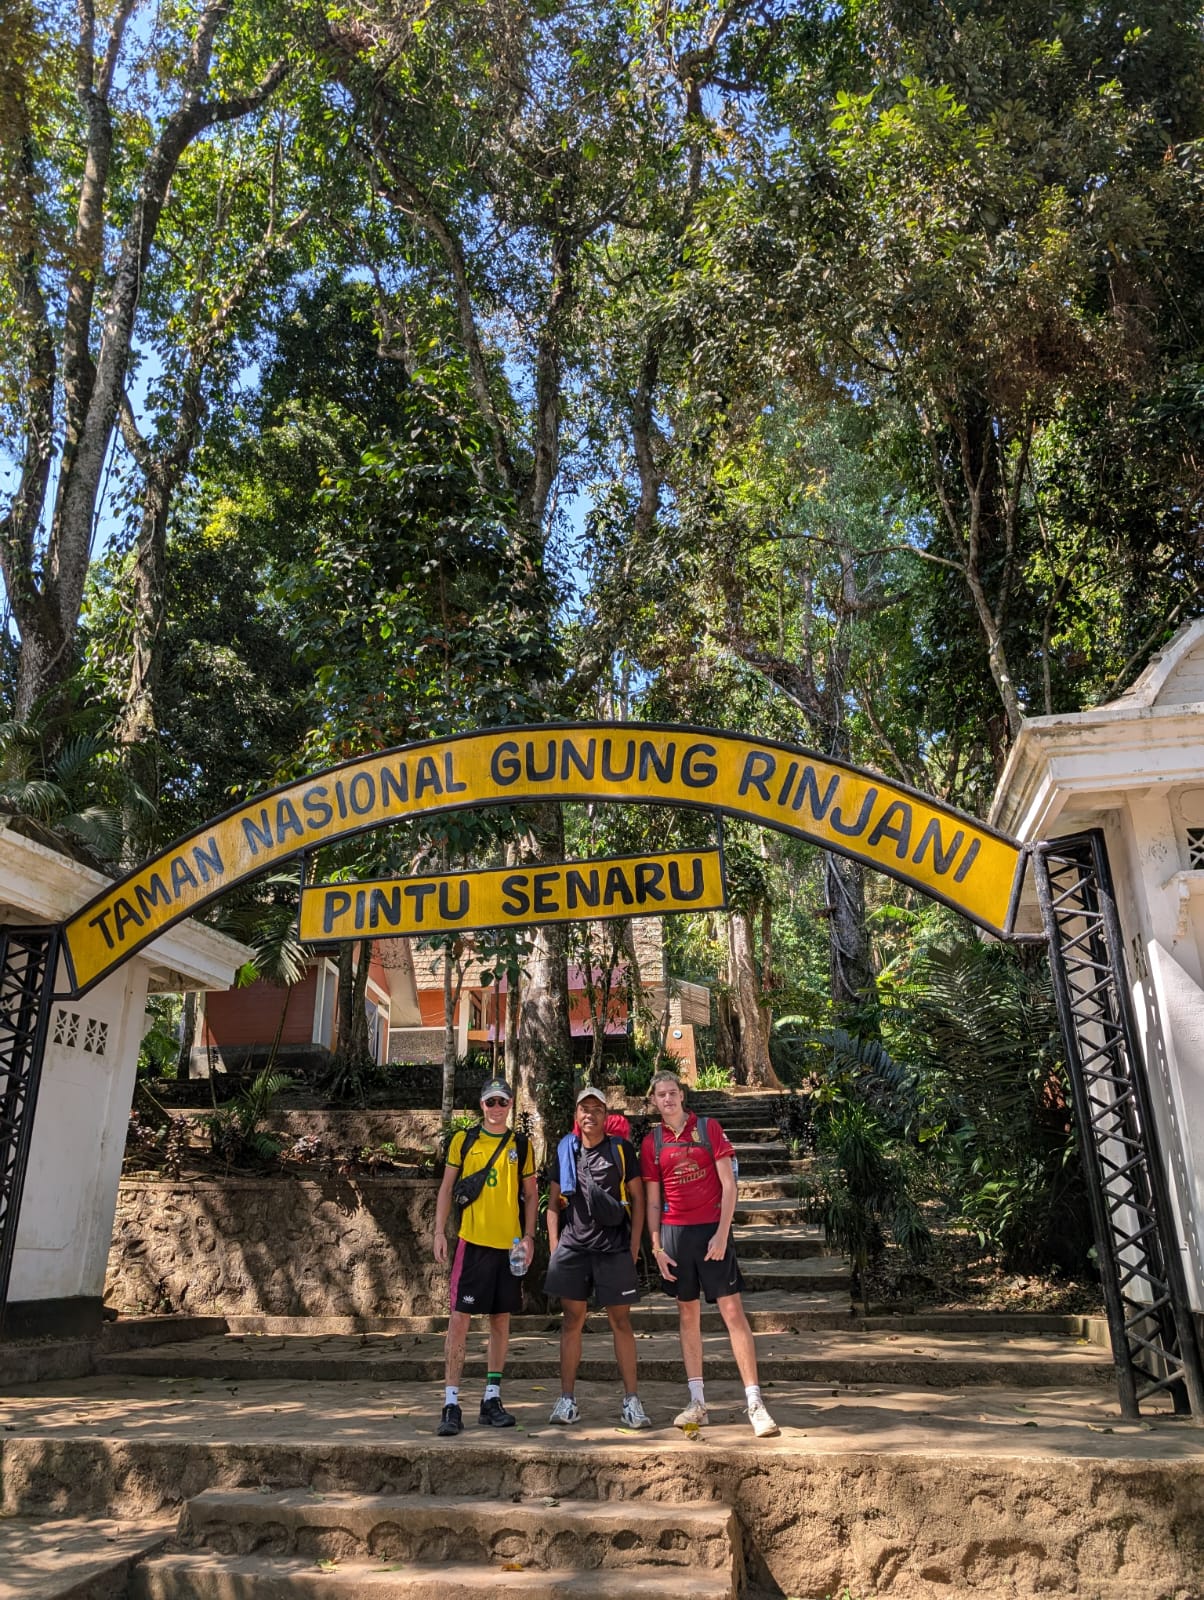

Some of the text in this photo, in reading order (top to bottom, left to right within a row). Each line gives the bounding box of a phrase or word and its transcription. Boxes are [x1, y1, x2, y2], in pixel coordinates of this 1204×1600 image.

[89, 739, 981, 949] TAMAN NASIONAL GUNUNG RINJANI
[323, 858, 704, 934] PINTU SENARU
[486, 1167, 498, 1188] 8
